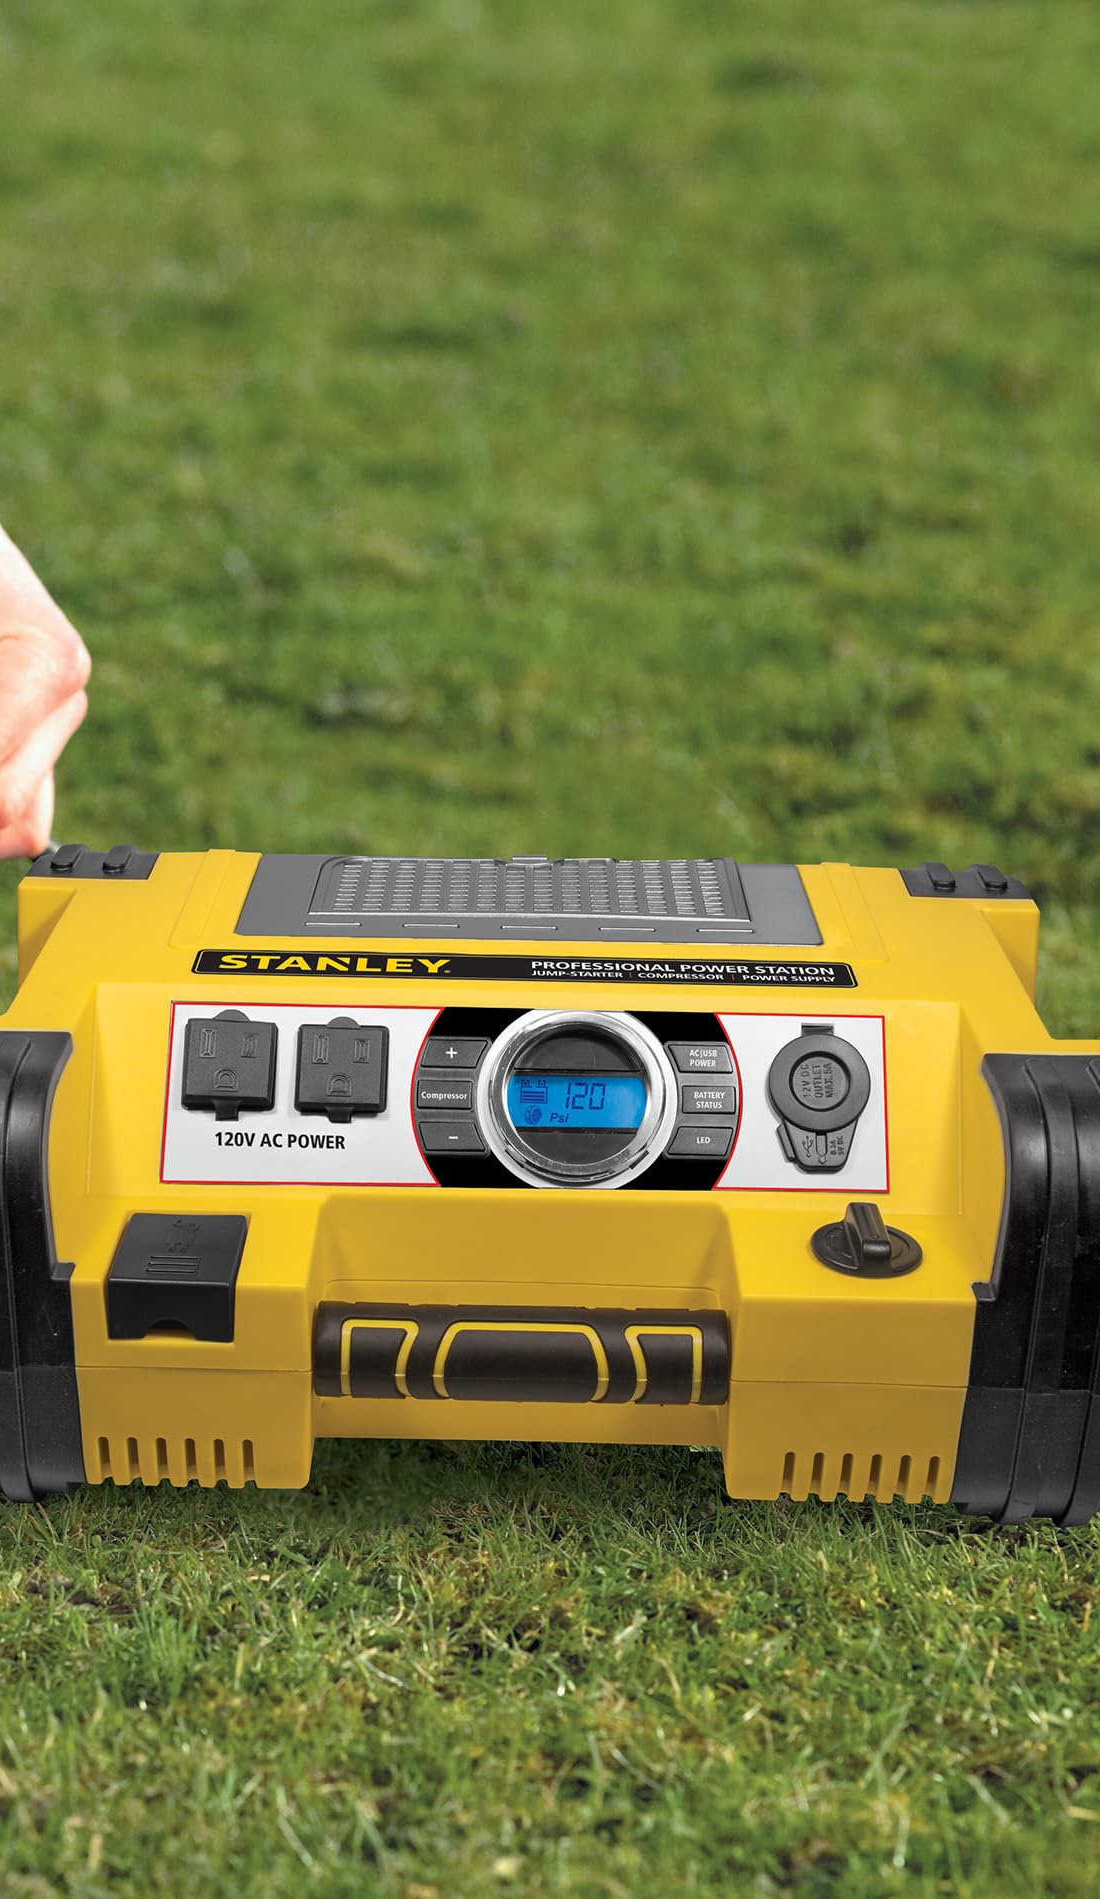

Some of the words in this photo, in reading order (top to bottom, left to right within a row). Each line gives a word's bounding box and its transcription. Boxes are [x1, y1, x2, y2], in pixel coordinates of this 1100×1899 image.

[218, 954, 451, 974] STANLEY
[531, 961, 675, 972] PROFESSIONAL
[680, 964, 750, 973] POWER
[754, 966, 835, 975] STATION
[531, 970, 623, 978] JUMP-STARTER
[637, 972, 724, 980] COMPRESSOR
[689, 1059, 716, 1067] POWER
[800, 1064, 810, 1077] DC
[812, 1063, 823, 1098] OUTLET
[693, 1091, 725, 1099] BATTERY
[802, 1080, 811, 1098] 12V
[420, 1091, 467, 1101] Compressor
[565, 1082, 606, 1110] 120
[549, 1112, 569, 1123] Psi
[215, 1131, 255, 1147] 120V
[260, 1133, 283, 1148] AC
[287, 1134, 345, 1149] POWER
[696, 1136, 711, 1144] LED
